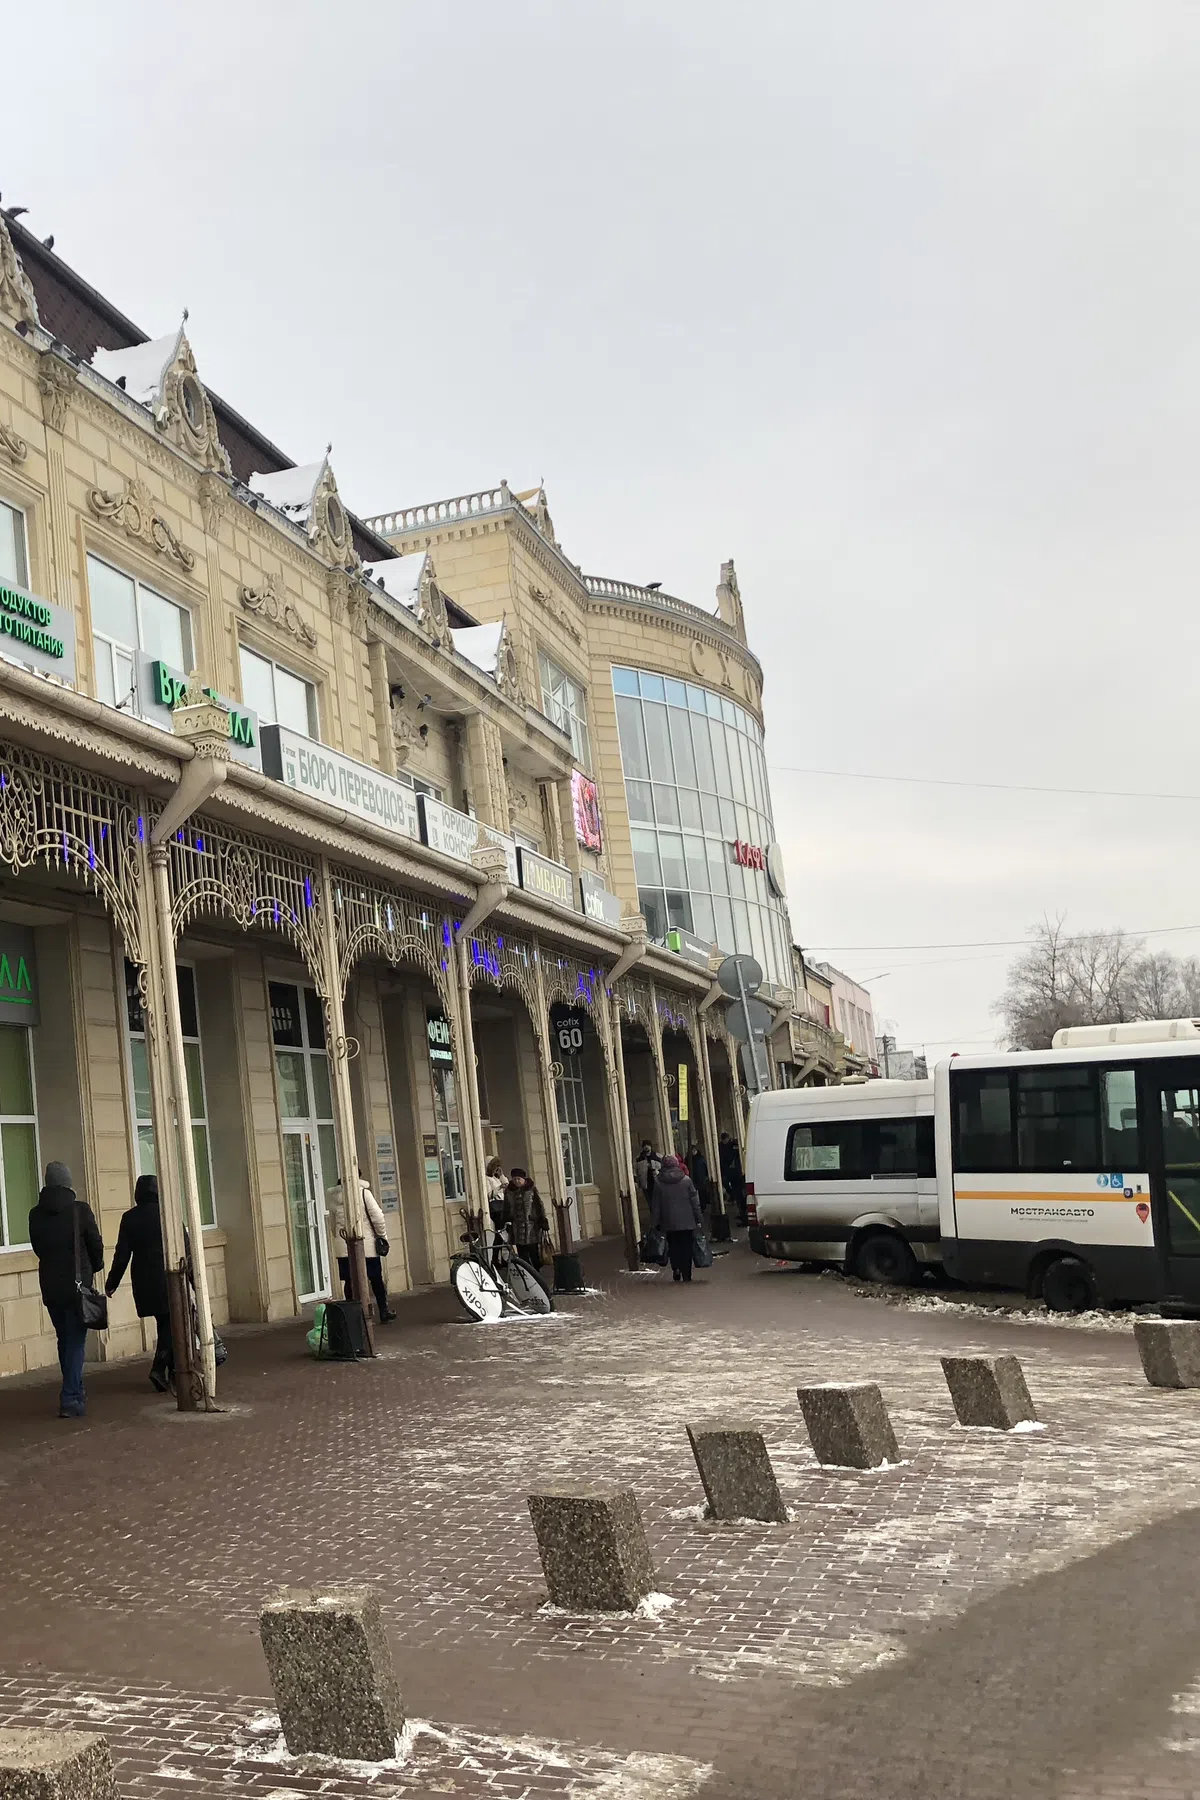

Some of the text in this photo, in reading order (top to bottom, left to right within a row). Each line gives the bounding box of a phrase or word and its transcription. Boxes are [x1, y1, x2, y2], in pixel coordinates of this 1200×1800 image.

[13, 620, 65, 657] ПИТАНИЯ
[299, 748, 404, 827] БЮРО ПЕРЕВОДОВ
[557, 1018, 579, 1027] cofix
[559, 1028, 583, 1049] 60
[1010, 1207, 1094, 1217] МОСТРАНСАВТО
[462, 1287, 487, 1317] cofix
